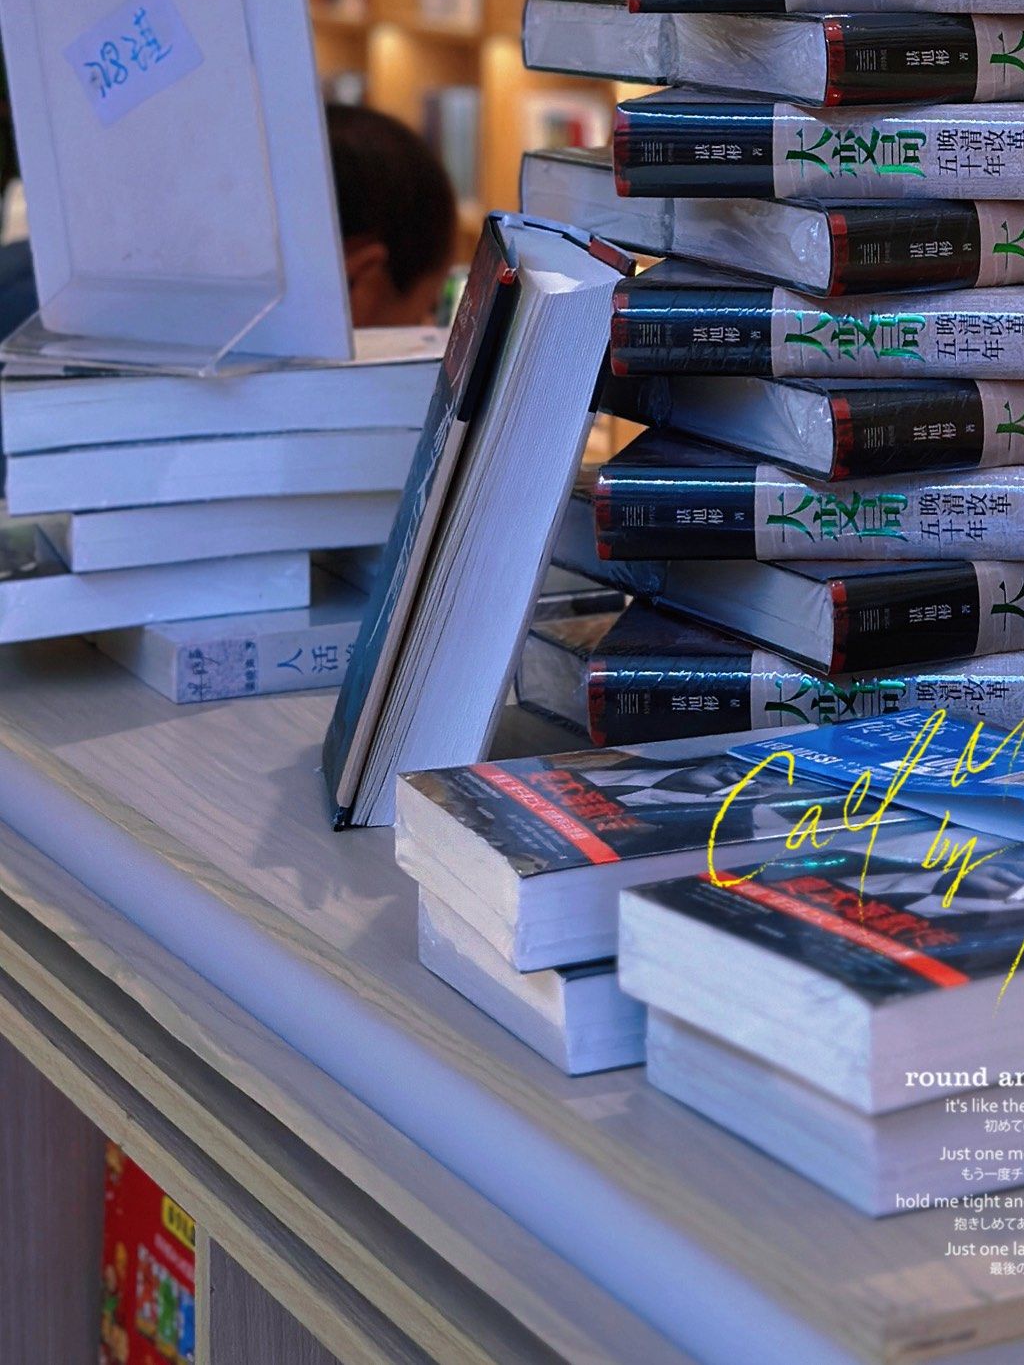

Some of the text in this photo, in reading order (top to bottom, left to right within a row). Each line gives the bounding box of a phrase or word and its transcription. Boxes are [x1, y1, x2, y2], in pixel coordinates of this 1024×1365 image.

[785, 126, 929, 181] 大变局
[937, 154, 1007, 178] 五十年
[784, 311, 928, 363] 大变局
[936, 336, 1005, 361] 五十年
[919, 493, 1013, 517] 晚清改革
[766, 493, 910, 544] 大变局
[920, 517, 989, 542] 五十年
